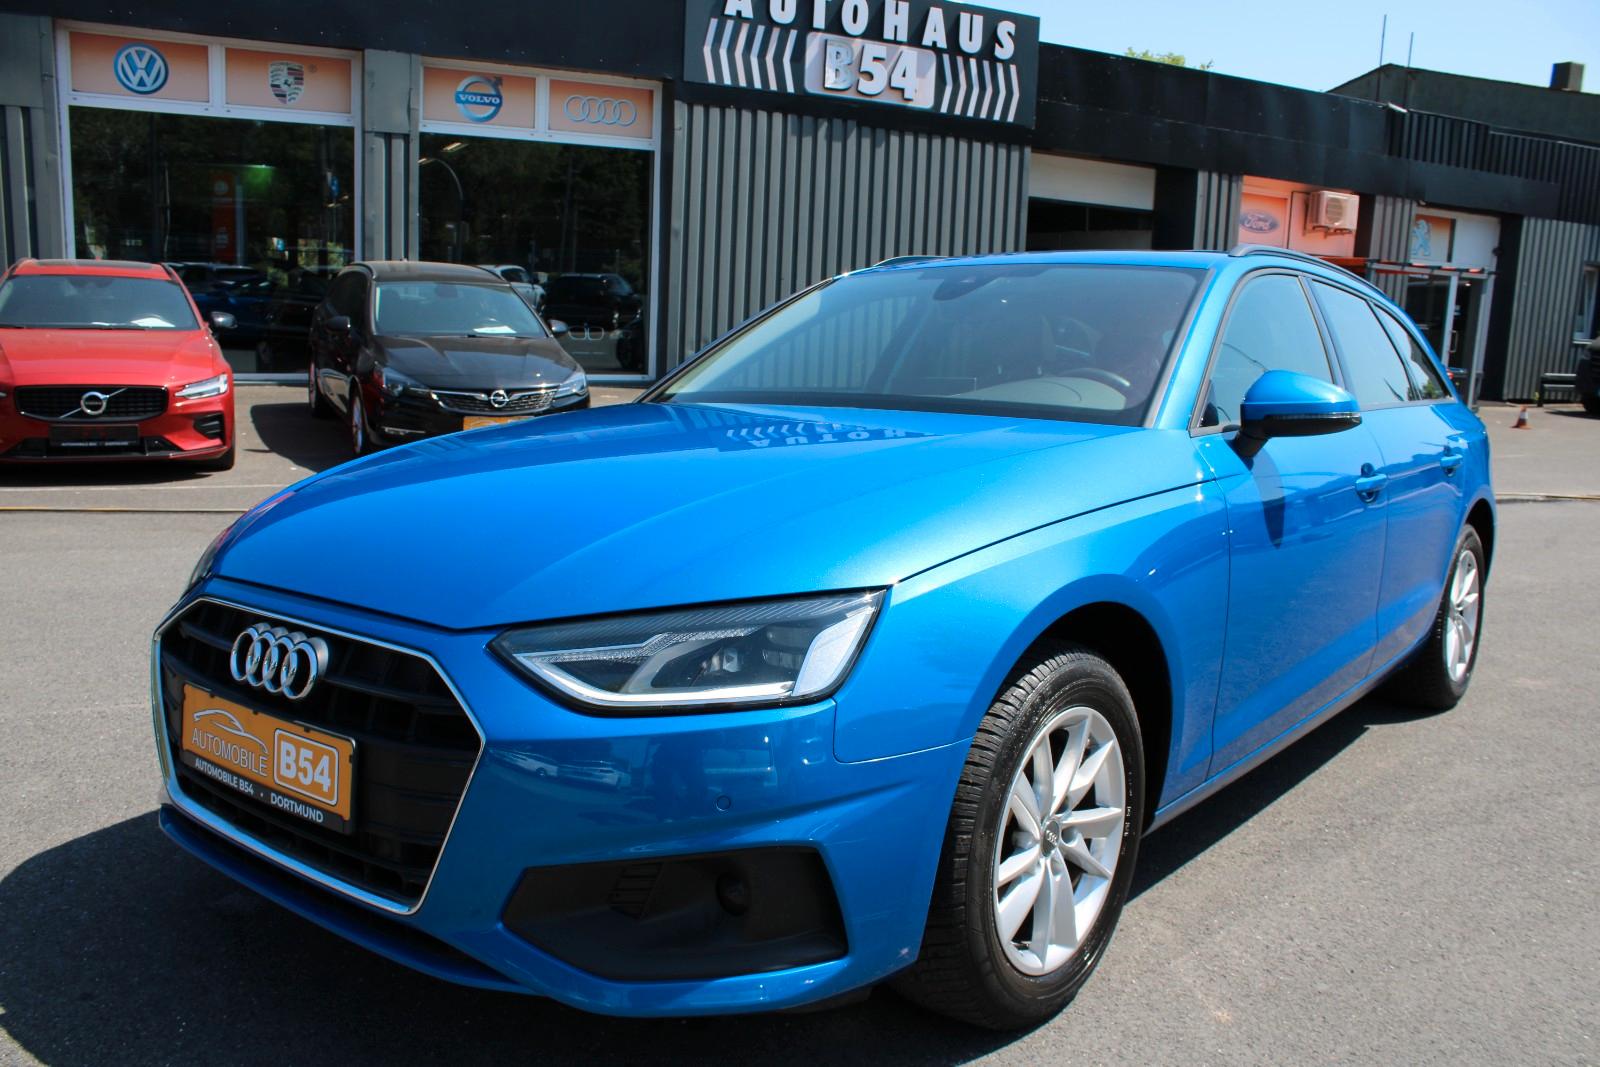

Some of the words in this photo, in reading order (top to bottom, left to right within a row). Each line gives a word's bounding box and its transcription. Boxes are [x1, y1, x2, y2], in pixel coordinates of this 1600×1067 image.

[458, 93, 500, 105] VOLVO
[824, 39, 918, 101] B54
[192, 727, 268, 777] AUTOMOBILE
[280, 740, 331, 793] B54
[195, 758, 238, 788] AUTOMOBILE
[239, 778, 254, 795] B54
[270, 792, 324, 823] DORTMUND
